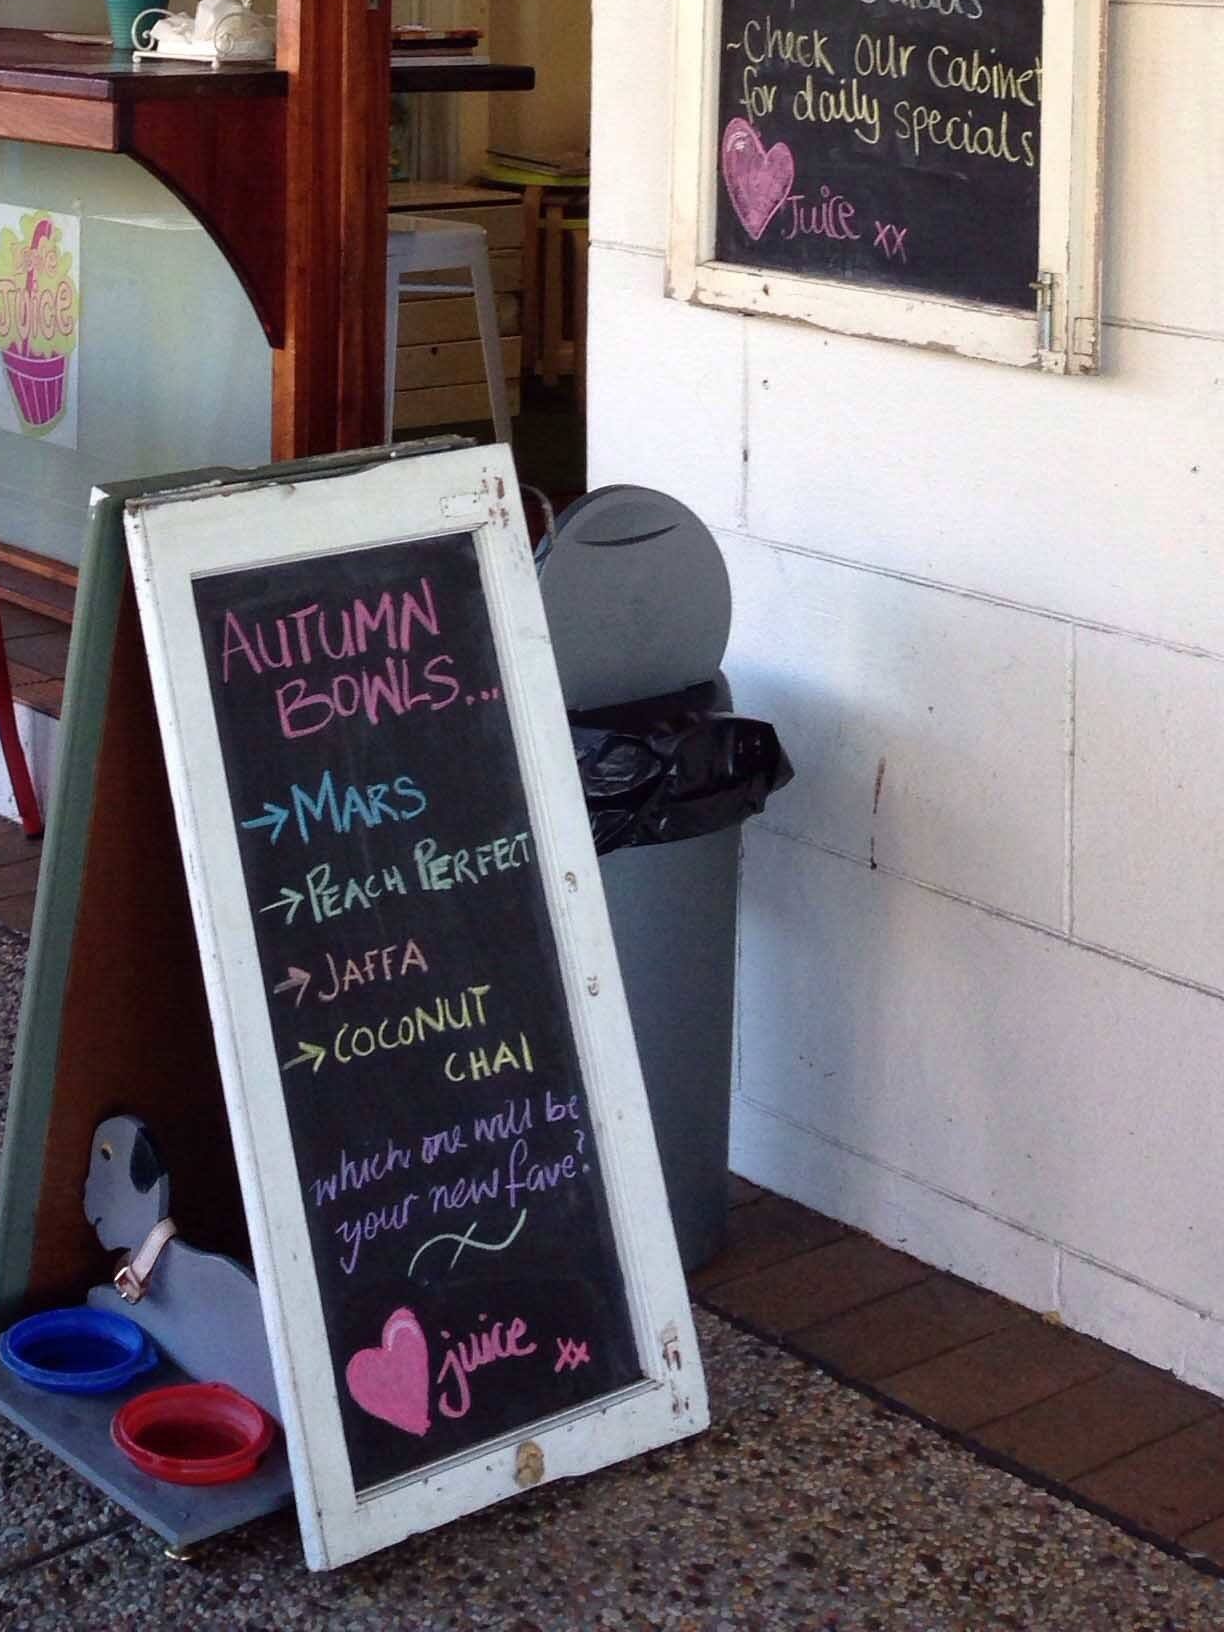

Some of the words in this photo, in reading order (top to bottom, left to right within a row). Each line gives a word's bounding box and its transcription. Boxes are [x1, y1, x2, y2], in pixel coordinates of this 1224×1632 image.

[740, 65, 777, 124] for
[792, 74, 881, 145] daily
[781, 185, 861, 241] Juice
[221, 577, 441, 685] AUTUMN
[289, 768, 428, 845] MARS
[304, 863, 407, 925] PEACH
[414, 831, 532, 892] PERFECT
[317, 938, 429, 1004] JAFFA
[333, 984, 492, 1064] COCONUT
[444, 1032, 533, 1082] CHAI
[310, 1137, 413, 1207] which
[421, 1124, 468, 1164] one
[475, 1097, 533, 1143] will
[545, 1090, 581, 1123] be
[335, 1193, 420, 1275] your
[429, 1167, 500, 1214] new
[504, 1129, 593, 1208] fave?
[436, 1313, 538, 1419] juice
